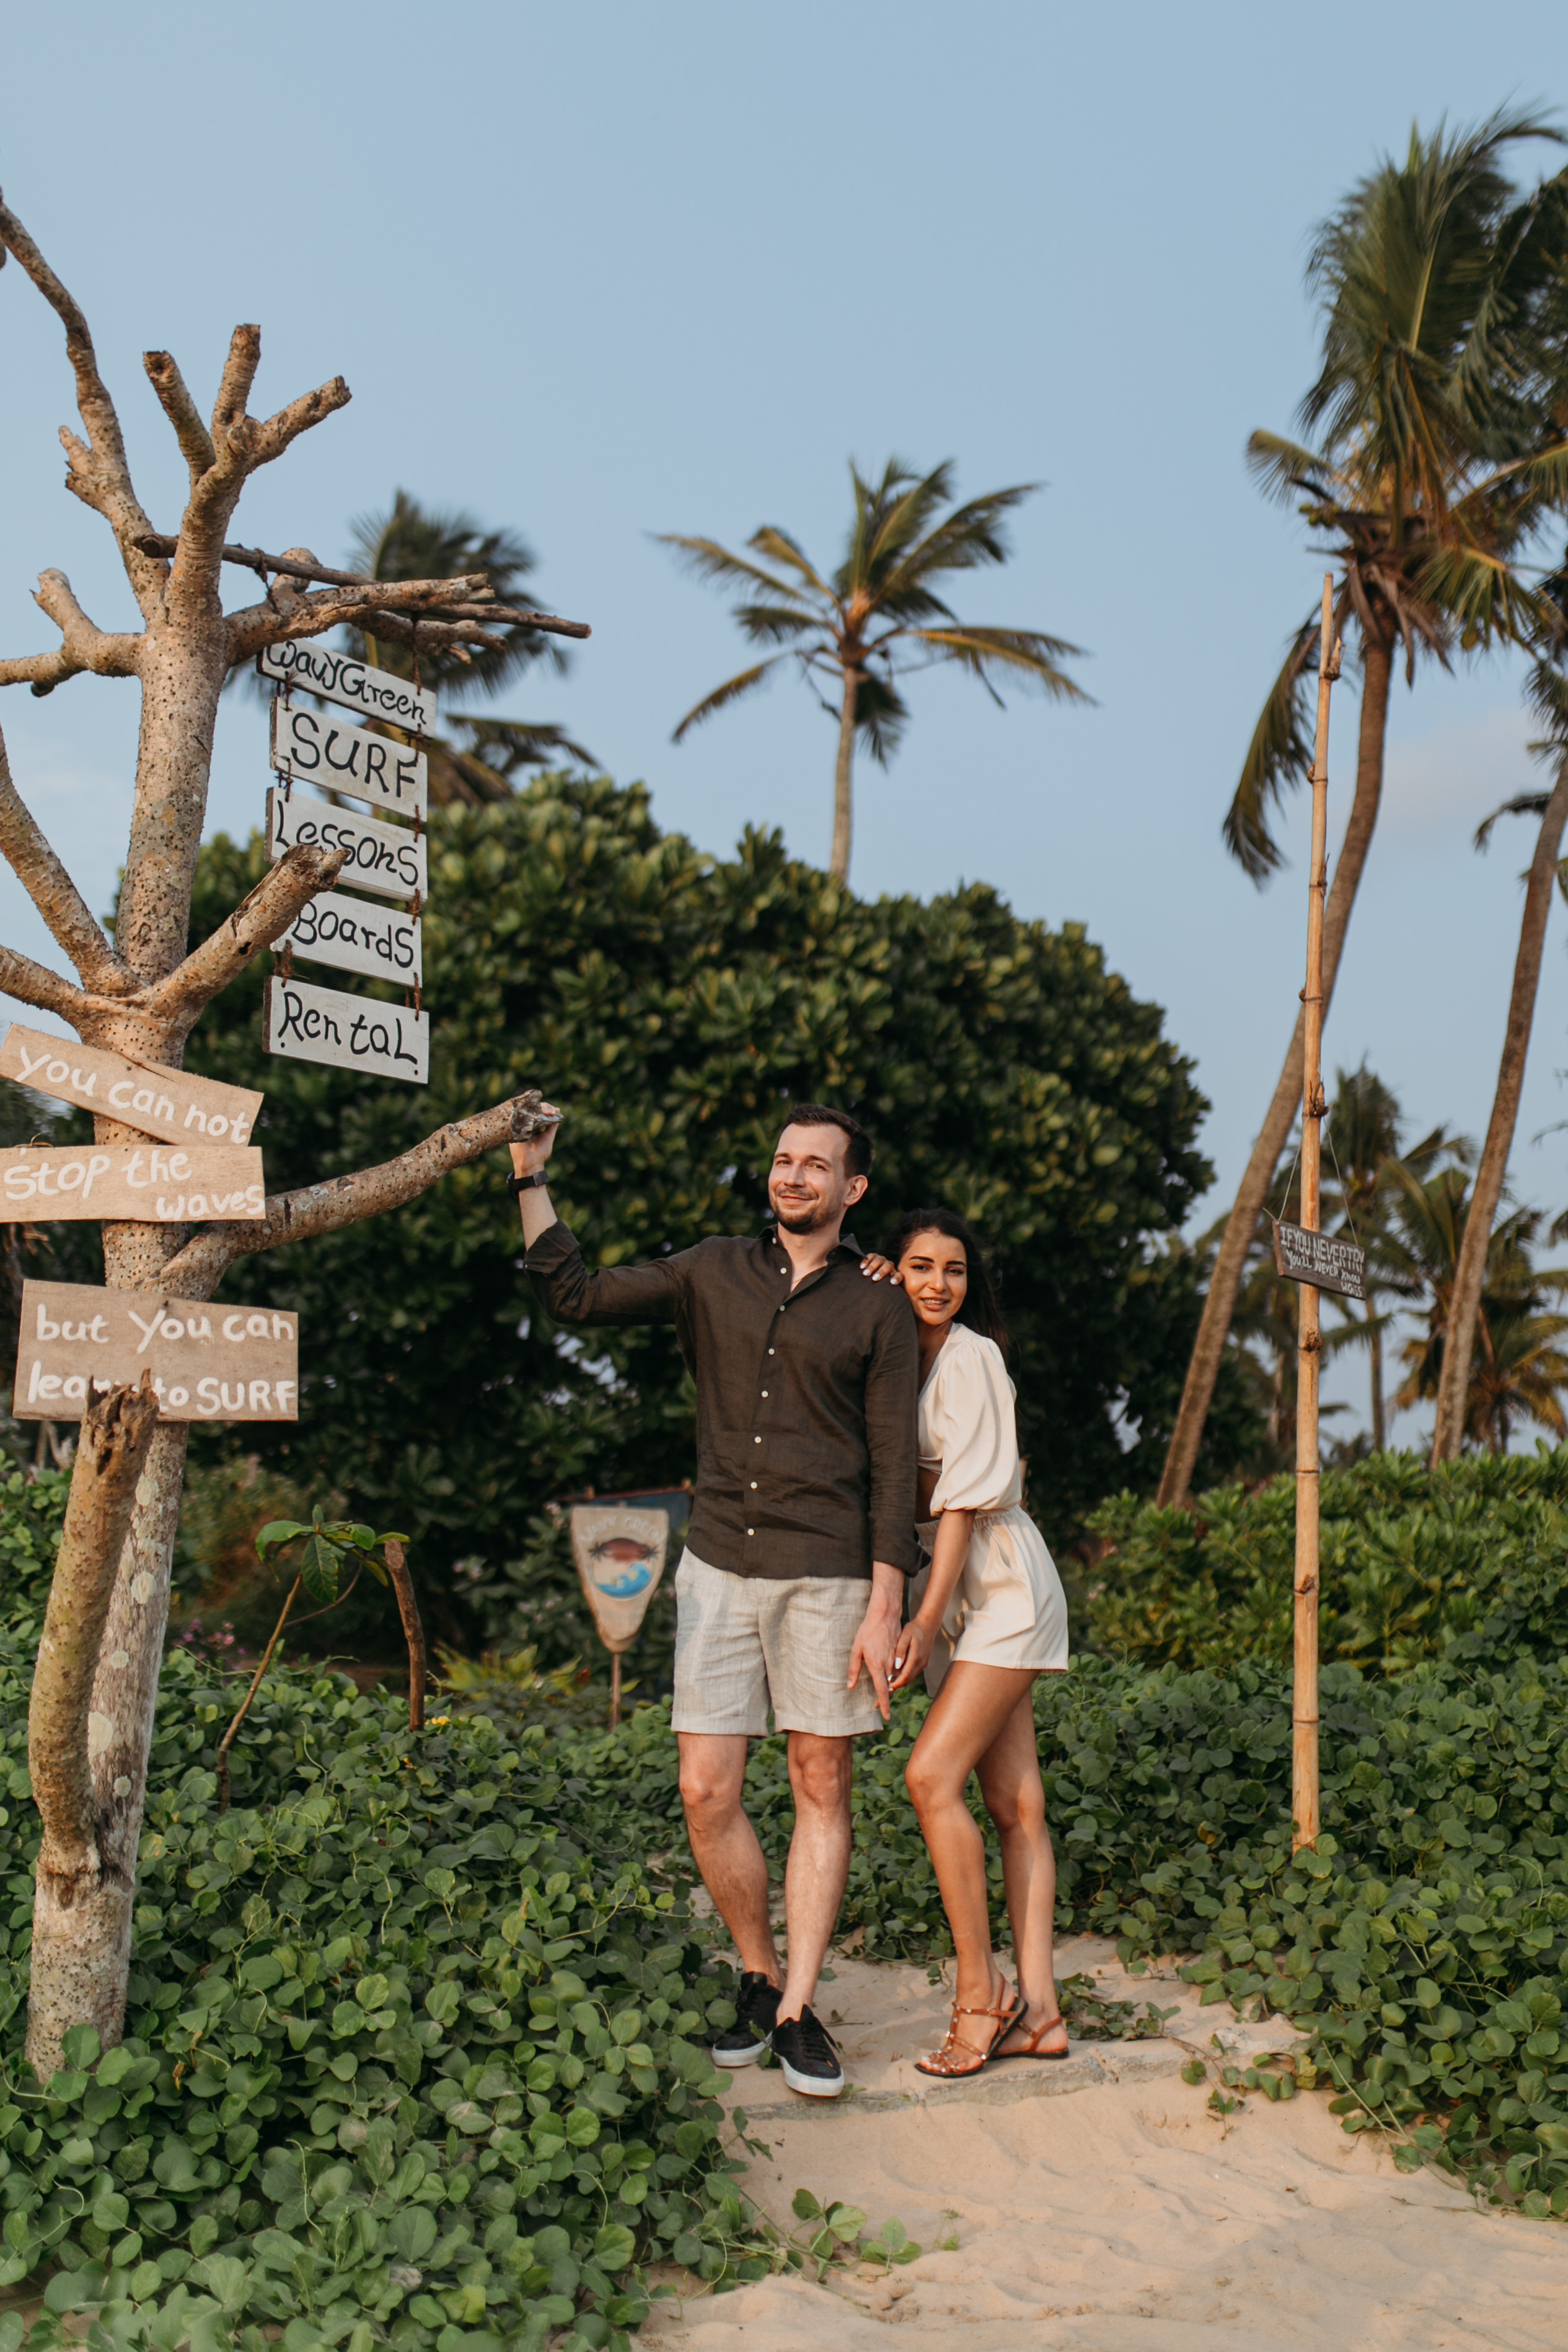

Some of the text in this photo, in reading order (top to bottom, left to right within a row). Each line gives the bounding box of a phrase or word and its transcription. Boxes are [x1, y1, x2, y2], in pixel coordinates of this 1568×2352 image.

[291, 712, 416, 797] SURF
[184, 1104, 250, 1144] not
[121, 1149, 193, 1188] the
[156, 1185, 265, 1220] waves
[37, 1303, 110, 1344] but
[222, 1313, 295, 1342] can
[196, 1376, 297, 1416] SURF
